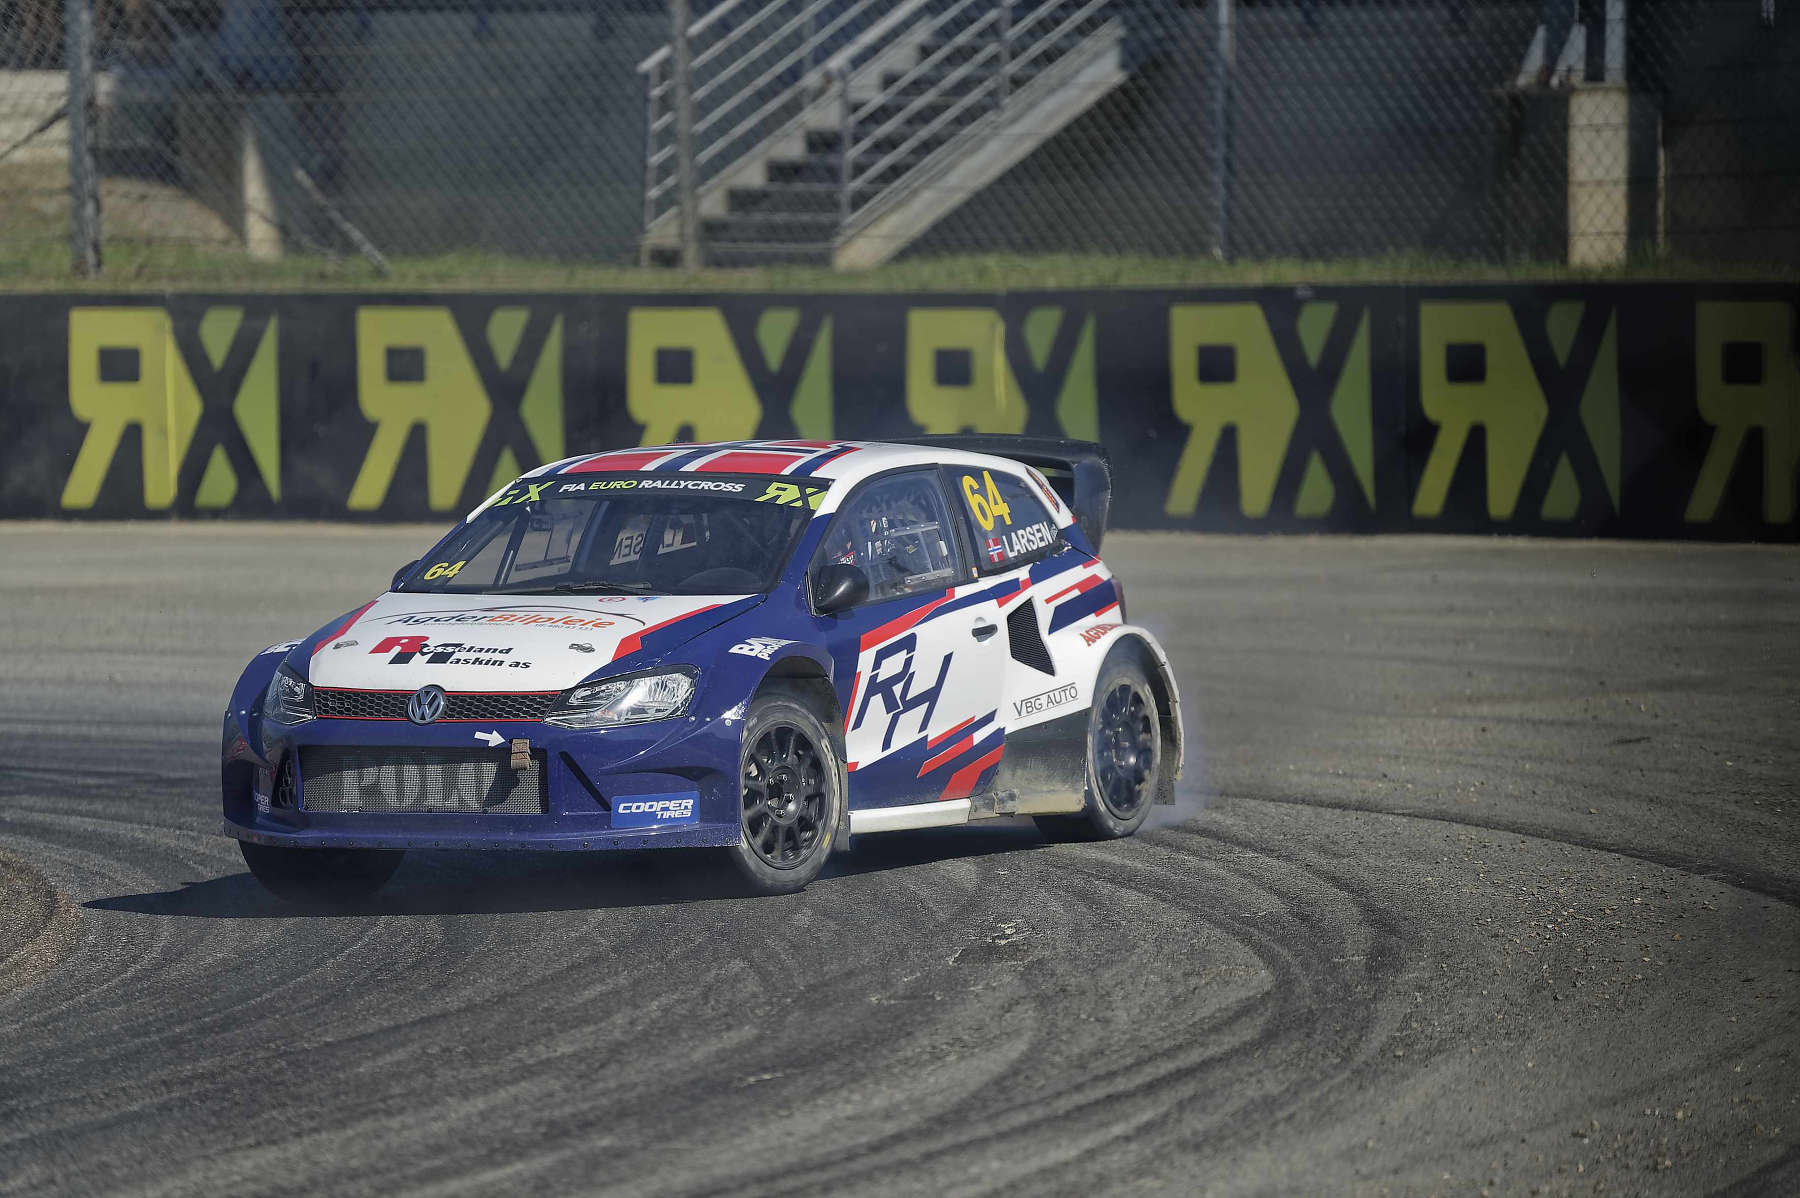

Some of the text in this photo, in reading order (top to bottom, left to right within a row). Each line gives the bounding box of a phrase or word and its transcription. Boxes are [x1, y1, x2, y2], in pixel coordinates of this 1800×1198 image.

[559, 480, 746, 493] FIA EURO RALLYCROSS
[961, 470, 1012, 531] 64
[1002, 521, 1053, 558] LARSEN
[424, 561, 467, 580] 64
[508, 661, 533, 669] as
[851, 632, 954, 752] RH
[1013, 686, 1078, 717] VBG AUTO
[618, 799, 694, 814] COOPER
[656, 809, 692, 819] TIRES
